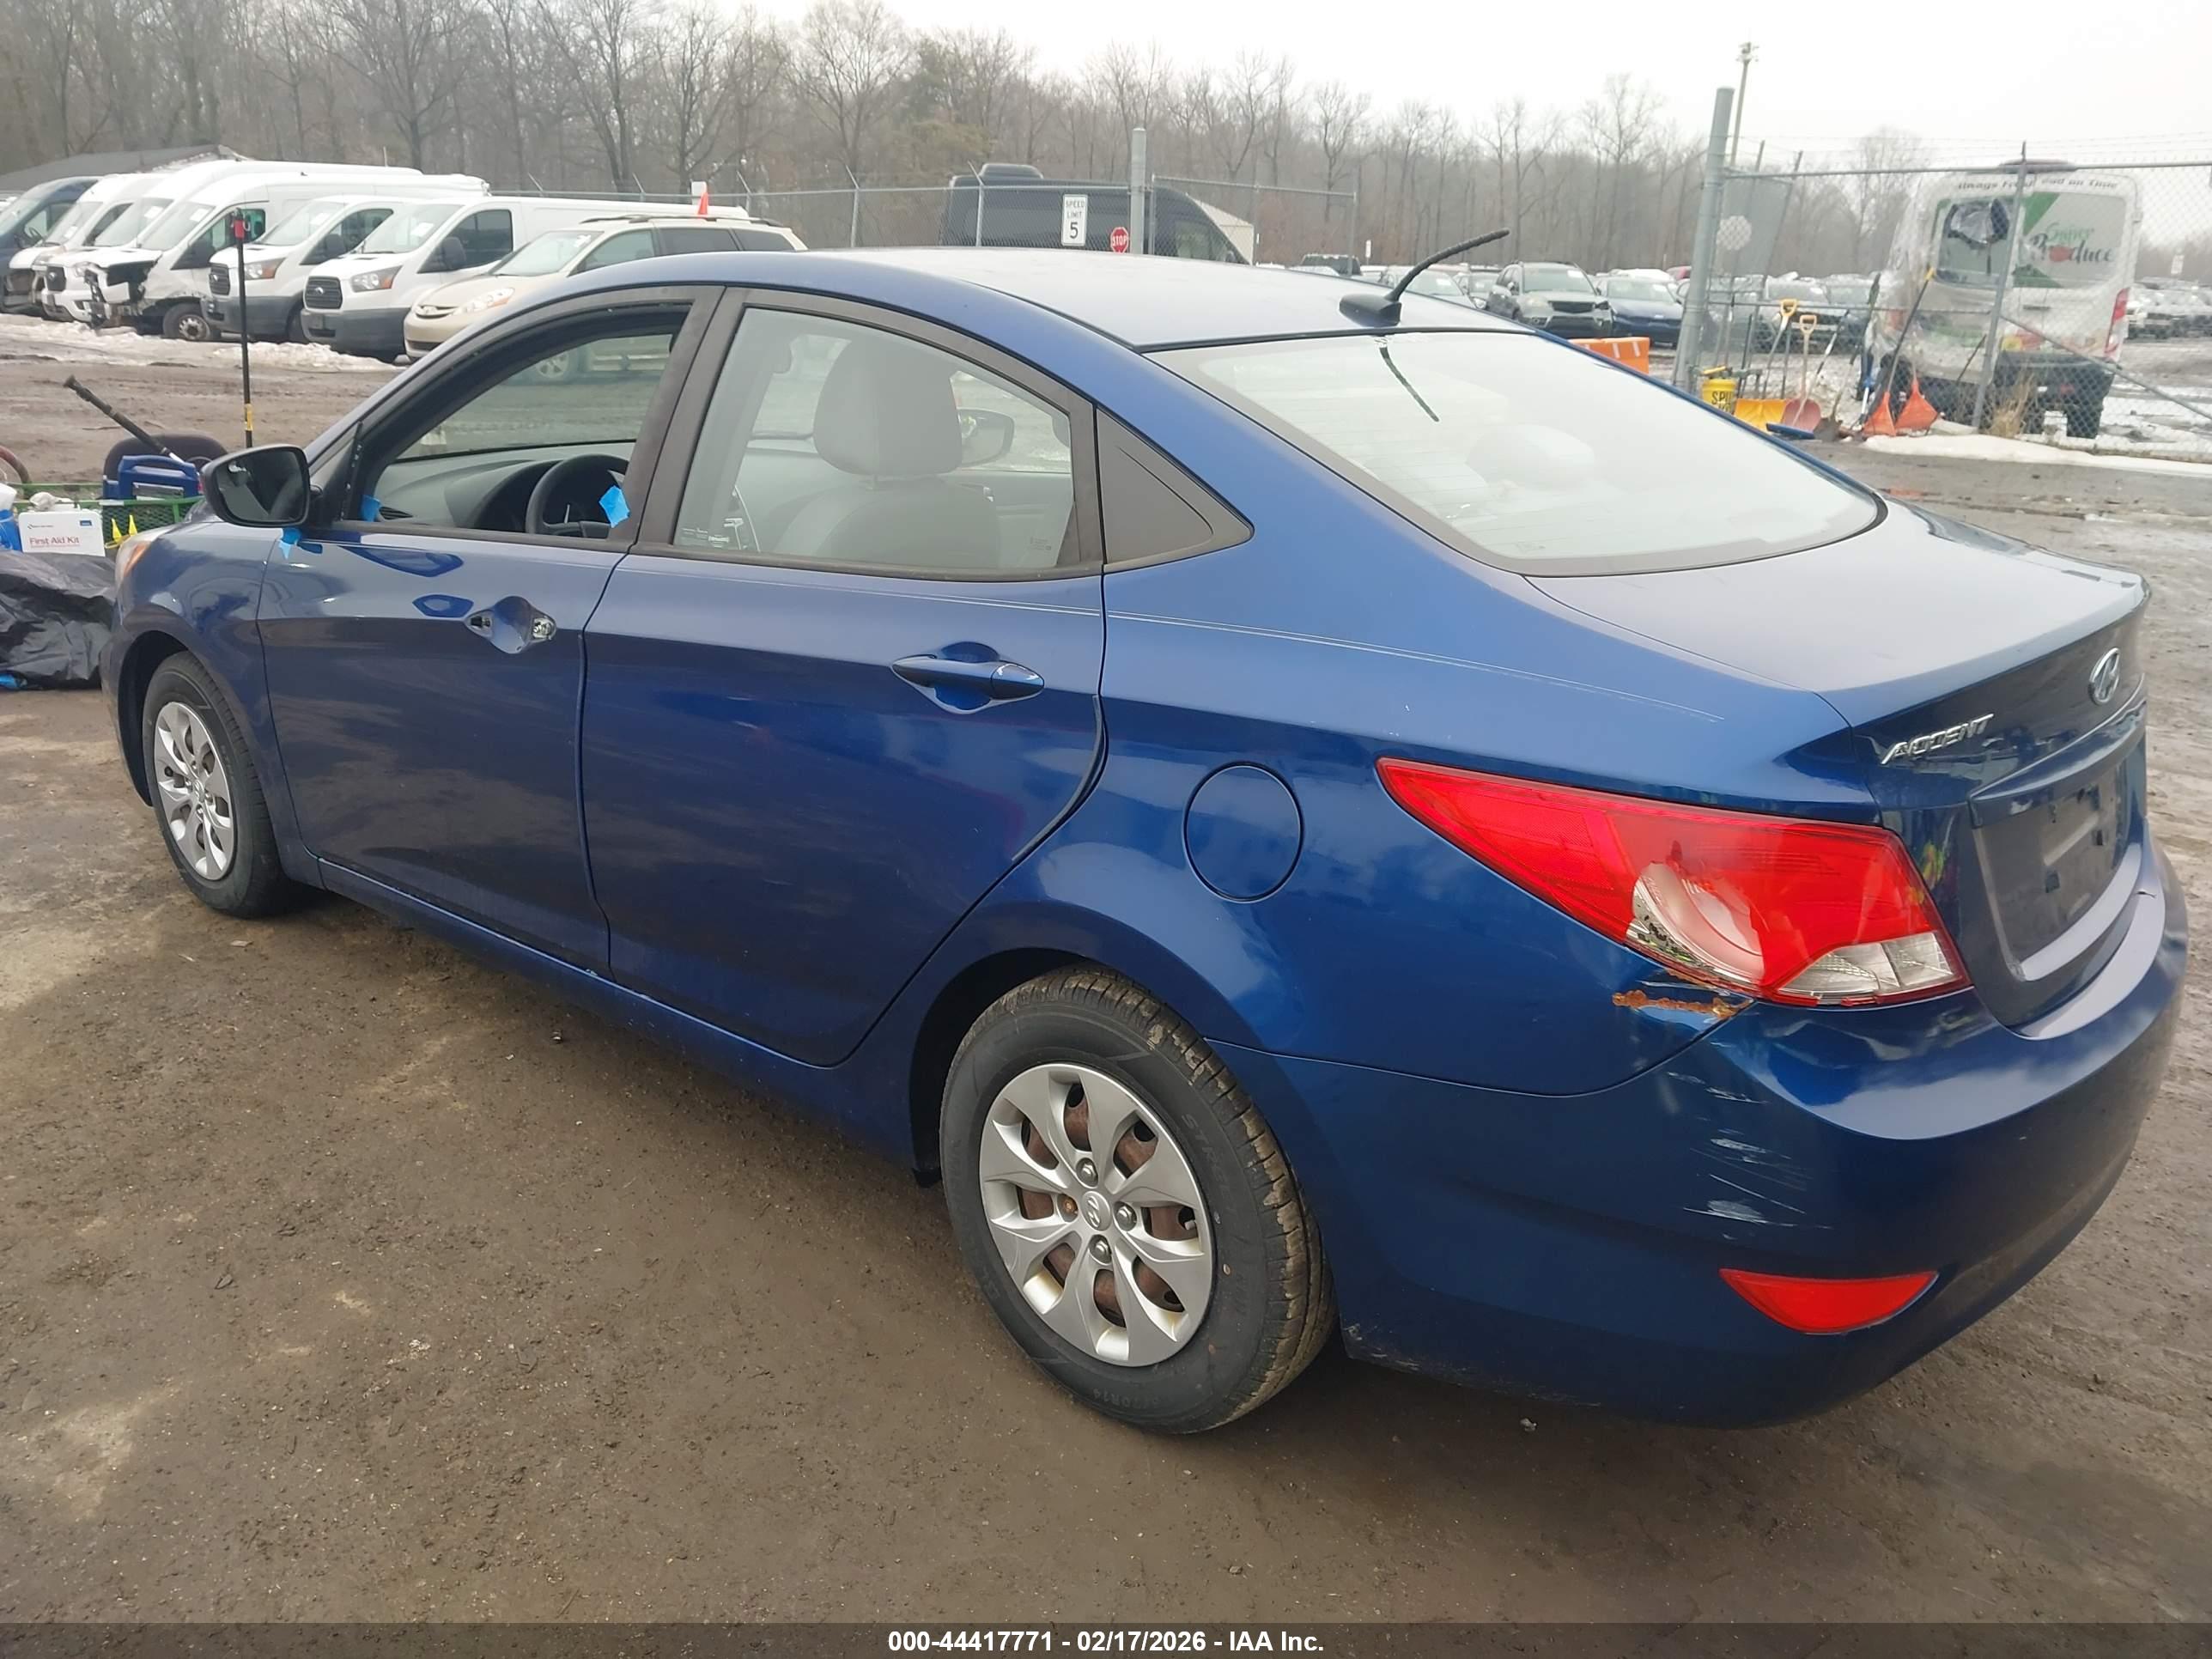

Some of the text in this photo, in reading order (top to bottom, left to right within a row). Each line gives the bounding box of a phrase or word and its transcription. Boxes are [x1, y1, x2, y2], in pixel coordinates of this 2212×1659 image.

[1066, 200, 1085, 209] SPEED
[1070, 221, 1079, 239] 5
[1111, 234, 1127, 247] STOP
[28, 535, 81, 545] First Aid Kit
[1880, 712, 1996, 765] ACCENT
